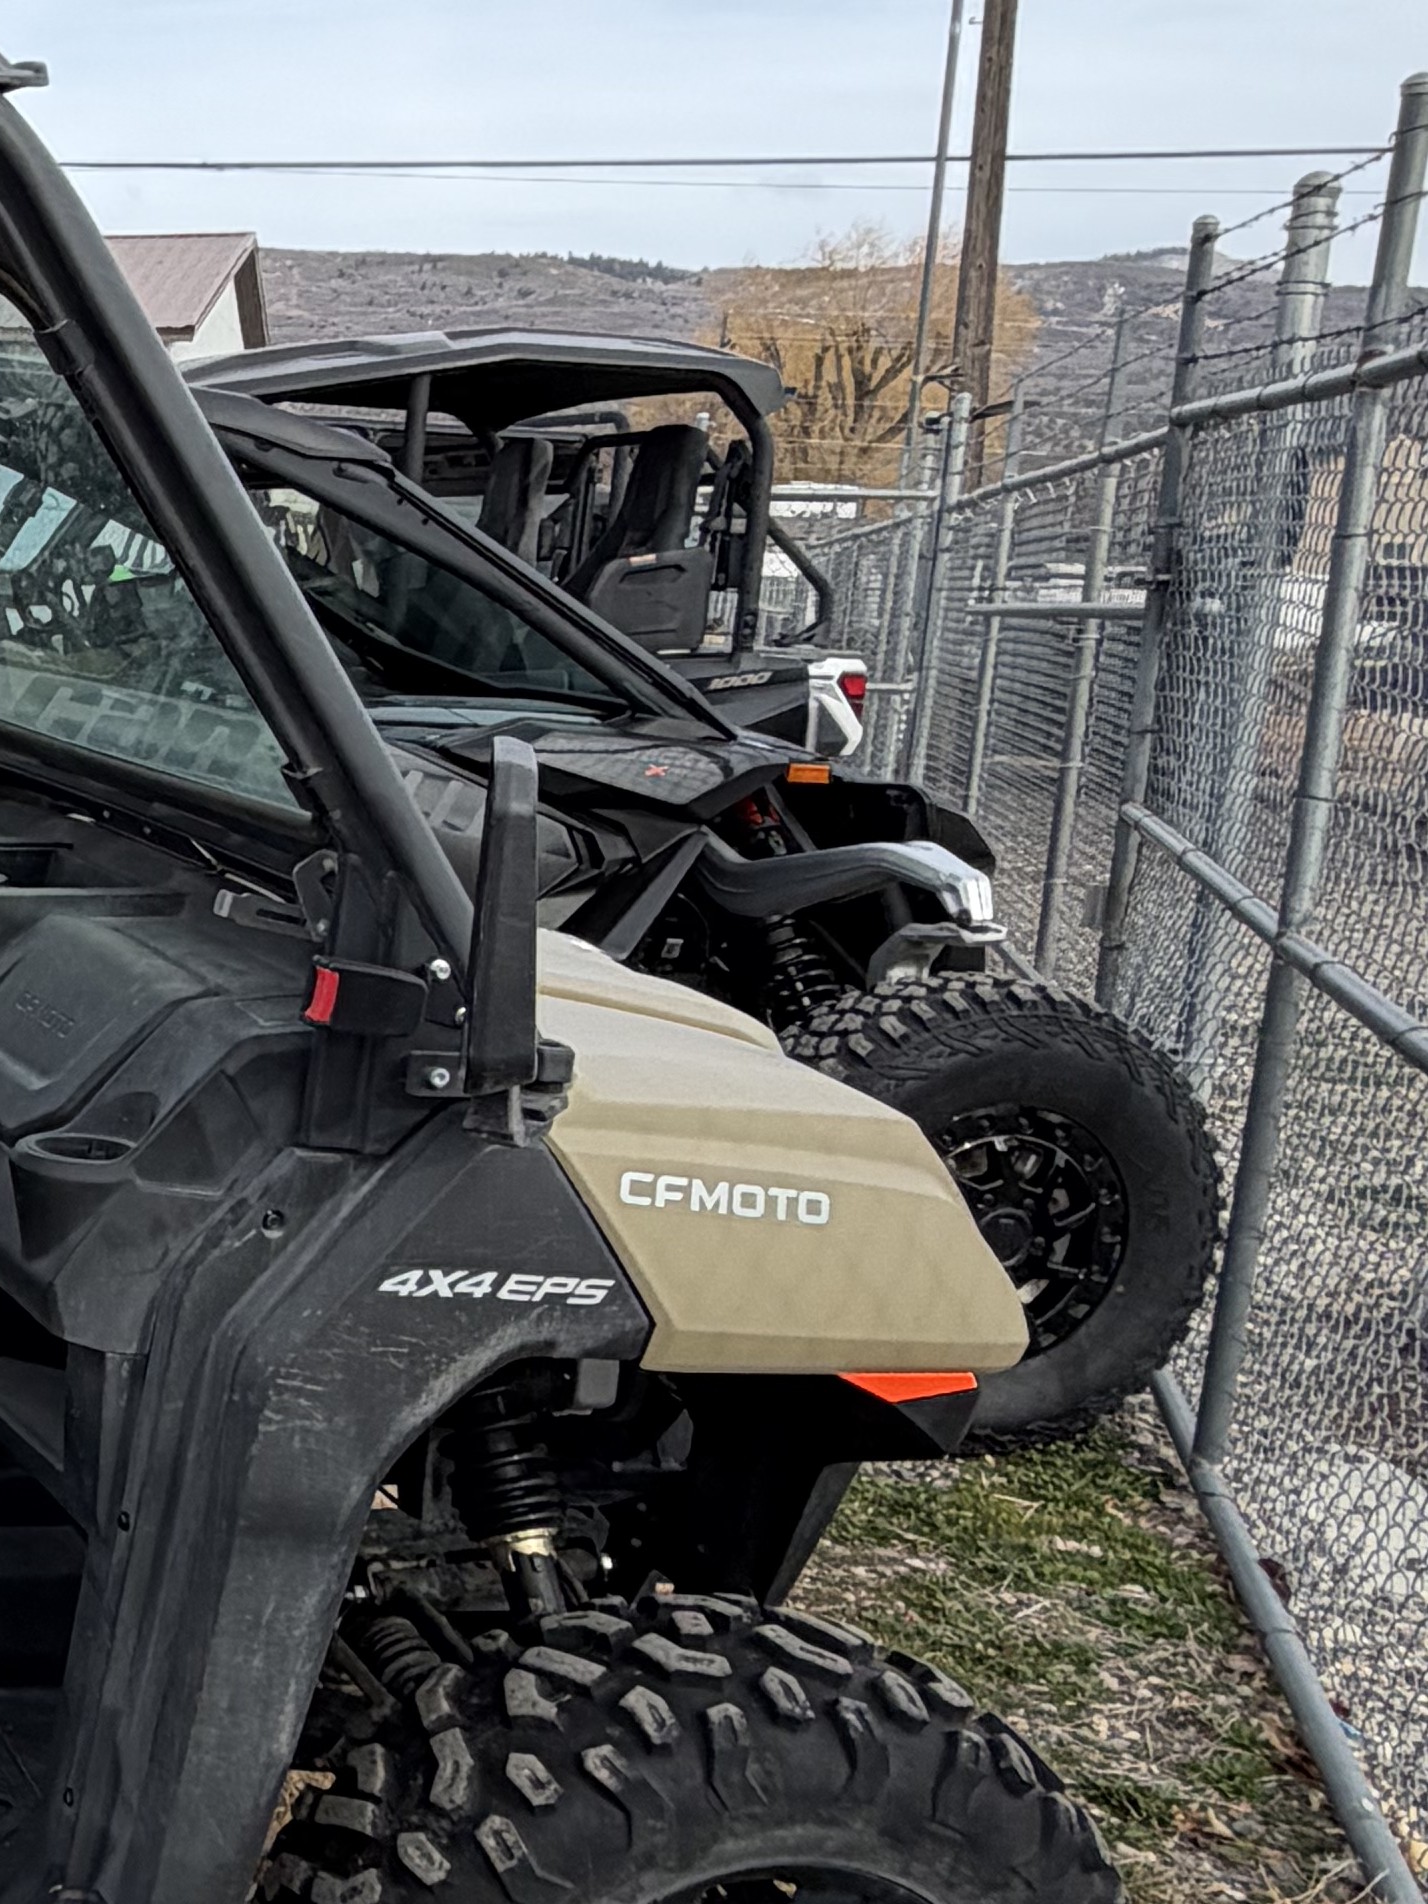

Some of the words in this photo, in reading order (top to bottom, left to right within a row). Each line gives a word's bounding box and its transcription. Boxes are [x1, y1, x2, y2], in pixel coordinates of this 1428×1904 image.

[706, 670, 775, 691] 1000
[619, 1171, 831, 1225] CFMOTO
[497, 1274, 616, 1305] EPS
